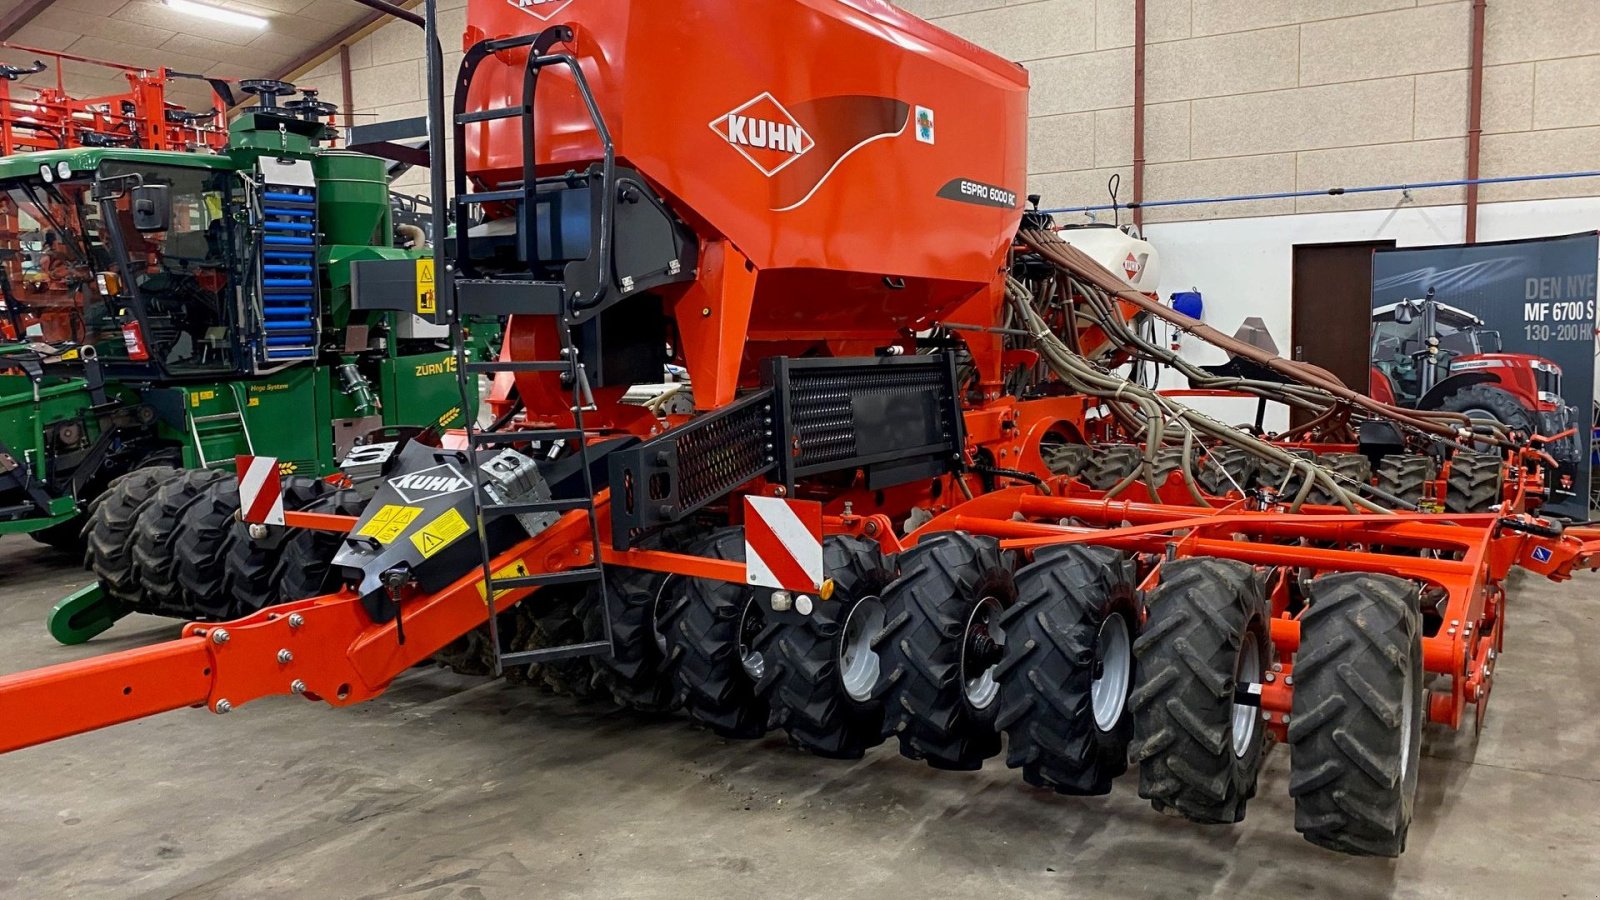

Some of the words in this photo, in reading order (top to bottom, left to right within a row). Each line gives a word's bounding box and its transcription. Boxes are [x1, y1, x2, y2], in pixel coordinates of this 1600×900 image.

[727, 113, 802, 155] KUHN
[960, 180, 988, 199] ESPRO
[989, 188, 1008, 204] 6000
[1008, 193, 1016, 207] RC
[1525, 276, 1562, 300] DEN
[1566, 273, 1595, 298] NYE
[1524, 302, 1550, 322] MF
[1552, 301, 1584, 321] 6700
[1586, 299, 1595, 320] S
[1579, 322, 1594, 341] HK
[415, 362, 443, 377] ZÜRN
[395, 473, 465, 493] KUHN
